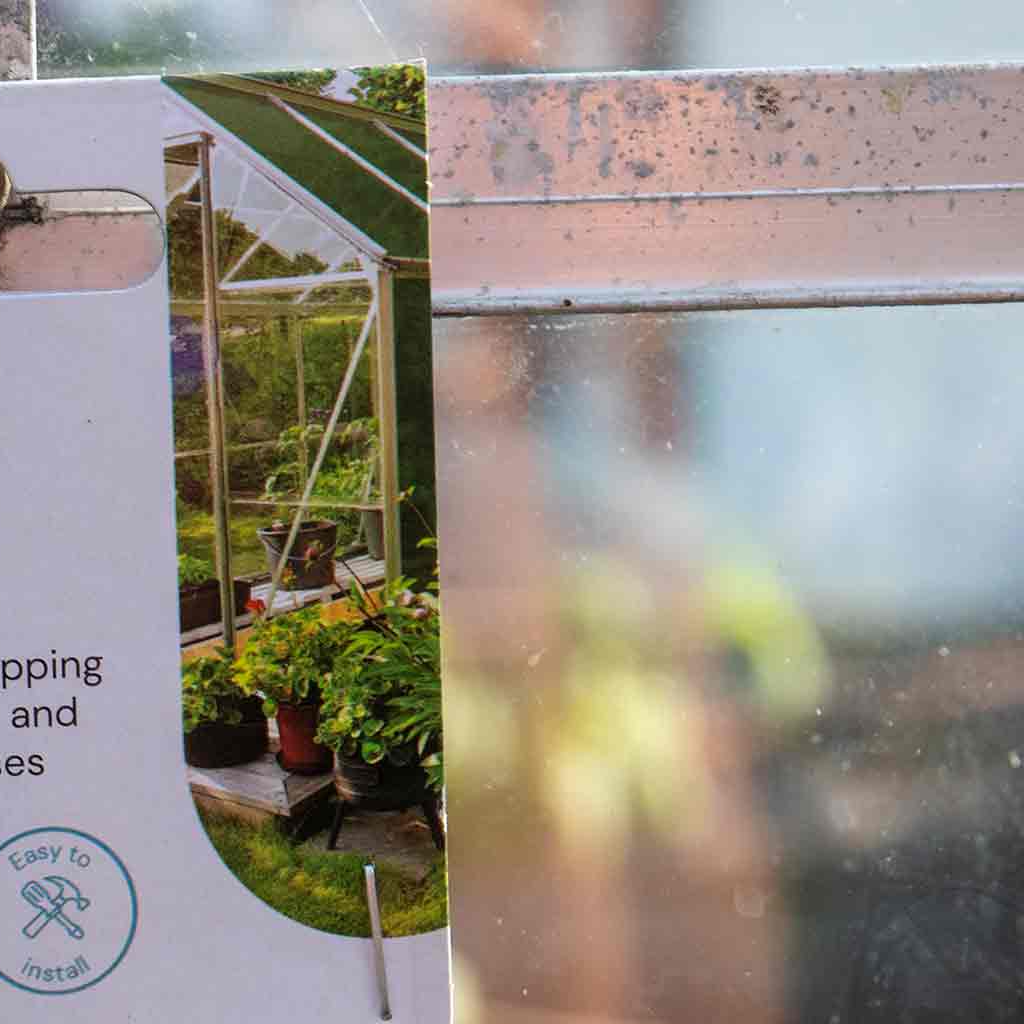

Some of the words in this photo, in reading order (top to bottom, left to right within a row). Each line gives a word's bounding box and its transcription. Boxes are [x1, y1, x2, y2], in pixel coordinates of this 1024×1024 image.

[11, 697, 78, 728] and
[8, 846, 62, 871] Easy
[70, 846, 90, 868] to
[21, 955, 90, 982] install
